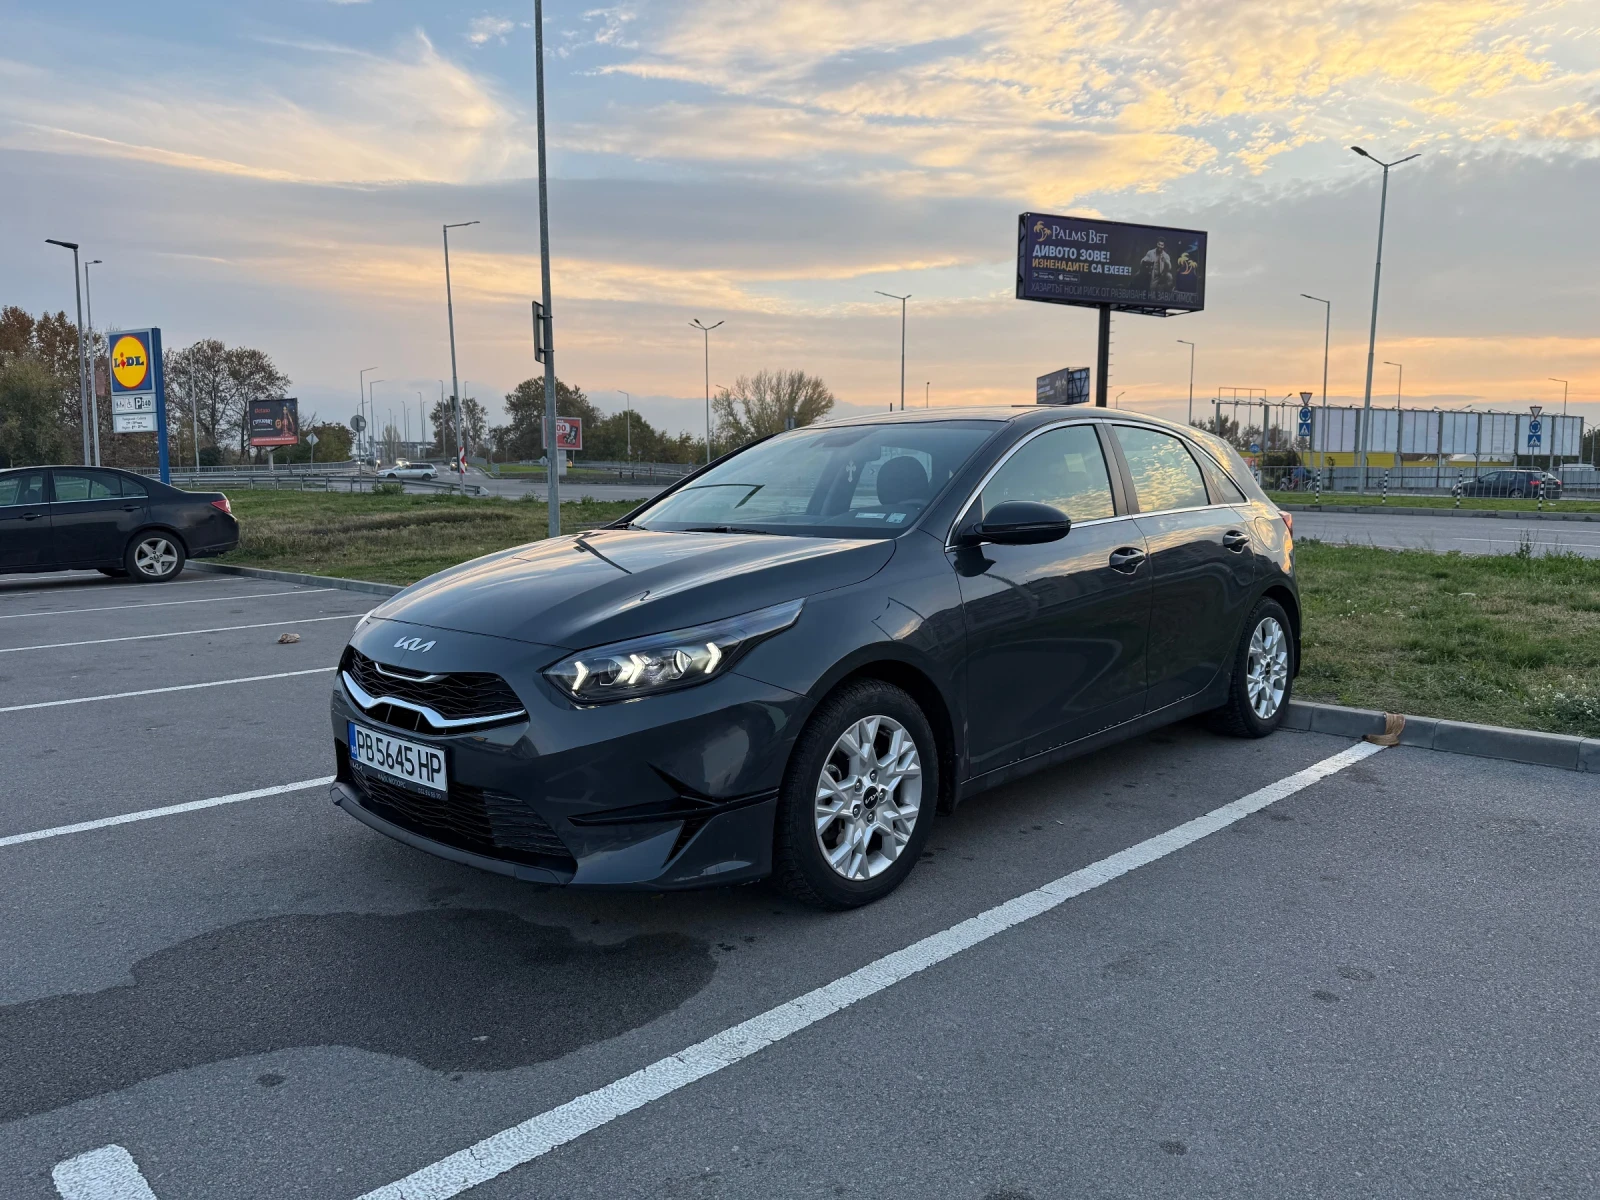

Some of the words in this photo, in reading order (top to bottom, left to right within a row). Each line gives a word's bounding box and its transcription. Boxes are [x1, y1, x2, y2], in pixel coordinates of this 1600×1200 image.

[1032, 244, 1077, 259] ДИВОТО
[1079, 249, 1110, 262] ЗОВЕ!
[1032, 258, 1089, 272] ИЗНЕНАДИТЕ
[1091, 264, 1102, 274] СА
[1104, 265, 1132, 276] ЕХЕЕЕ!
[1031, 282, 1063, 294] ХАЗАРТЪТ
[1064, 285, 1082, 295] НОСИ
[1083, 287, 1100, 297] РИСК
[1101, 287, 1110, 297] ОТ
[1110, 287, 1147, 300] РАЗВИВАНЕ
[1147, 290, 1157, 300] НА
[356, 729, 375, 762] PB
[376, 736, 415, 776] 5645
[417, 749, 441, 783] HP
